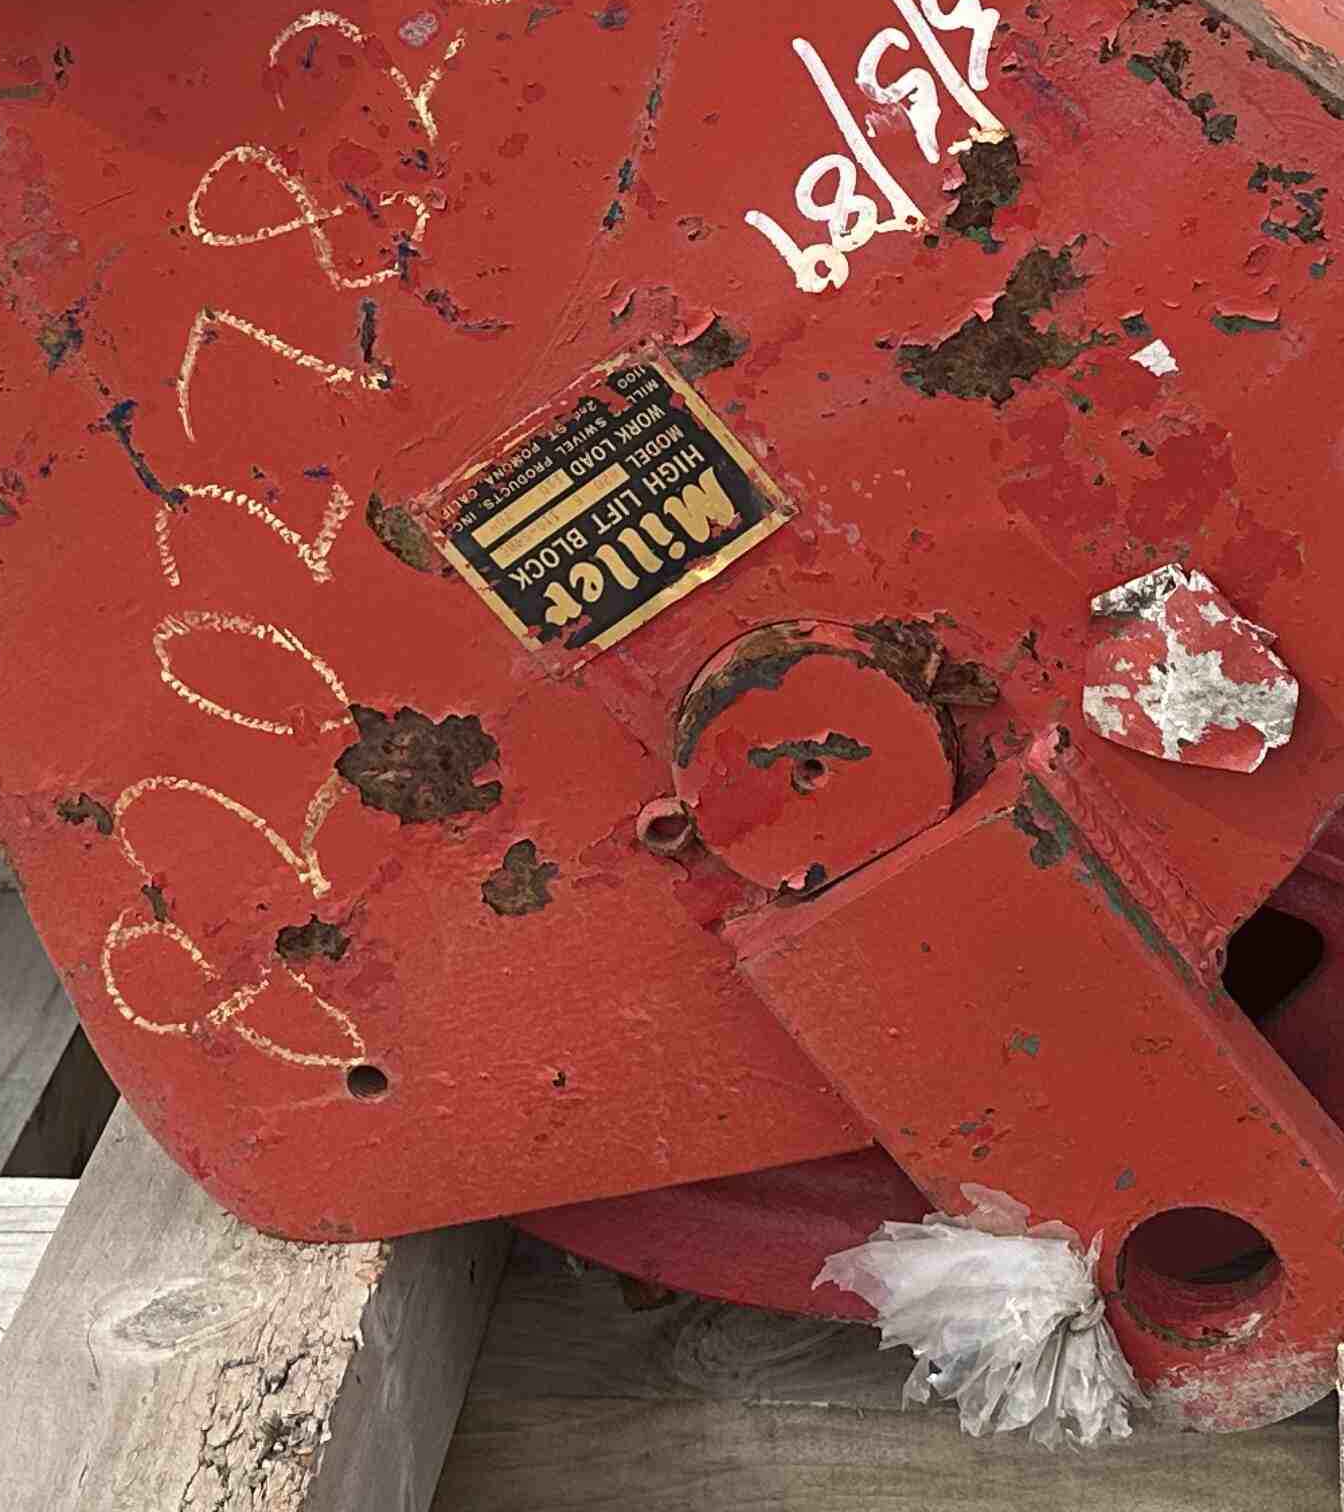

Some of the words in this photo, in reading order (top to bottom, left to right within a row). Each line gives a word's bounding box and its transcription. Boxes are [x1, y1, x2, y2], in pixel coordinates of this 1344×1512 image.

[617, 364, 648, 390] 1100
[554, 416, 607, 456] SWIVEL
[613, 404, 667, 445] WORK
[625, 423, 685, 469] MODEL
[570, 438, 616, 478] LOAD
[643, 445, 705, 496] HIGH
[590, 489, 643, 535] LIFT
[508, 527, 589, 590] BLOCK
[543, 464, 736, 626] Miller
